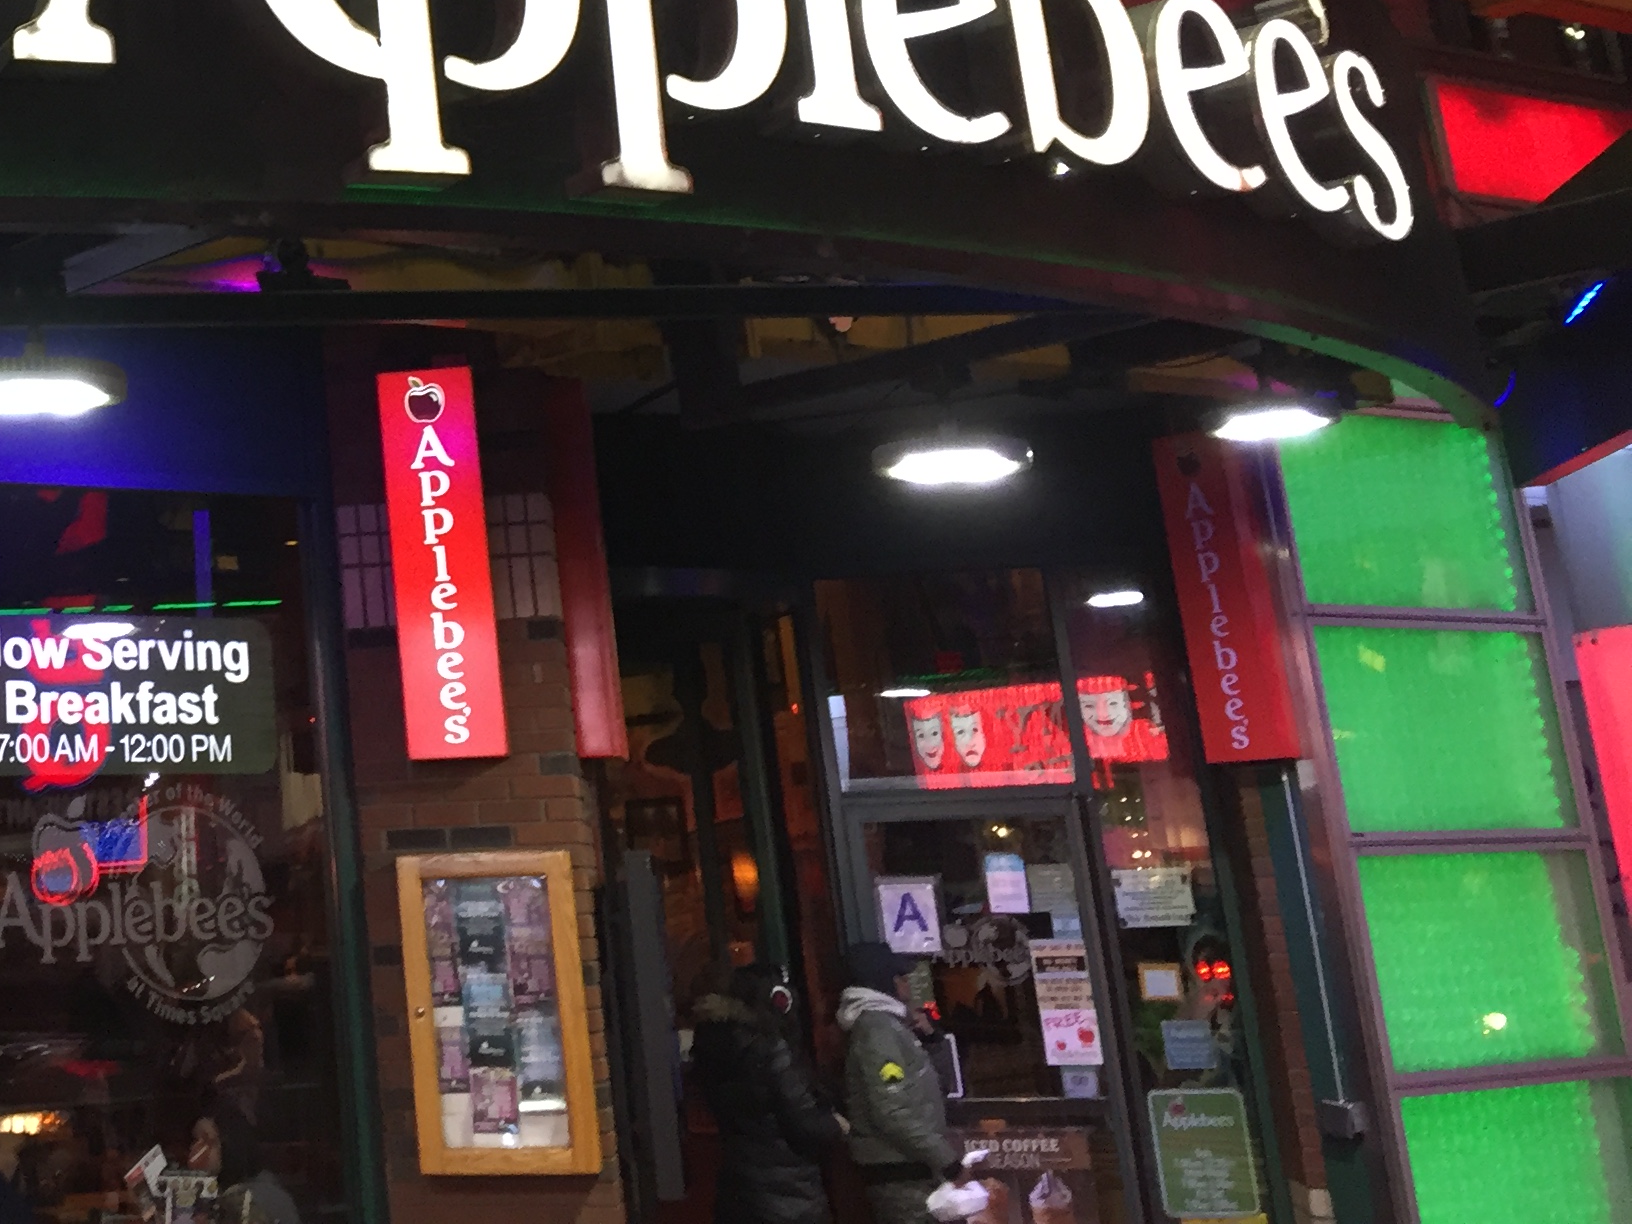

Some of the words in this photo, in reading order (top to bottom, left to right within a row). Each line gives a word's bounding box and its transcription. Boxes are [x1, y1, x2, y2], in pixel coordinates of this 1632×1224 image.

[410, 425, 473, 745] Applebee's
[1186, 482, 1249, 750] Applebee's
[81, 629, 249, 683] Serving
[5, 680, 219, 724] Breakfast
[54, 733, 99, 763] AM
[119, 733, 184, 763] 12:00
[191, 733, 232, 763] PM
[893, 892, 929, 932] A
